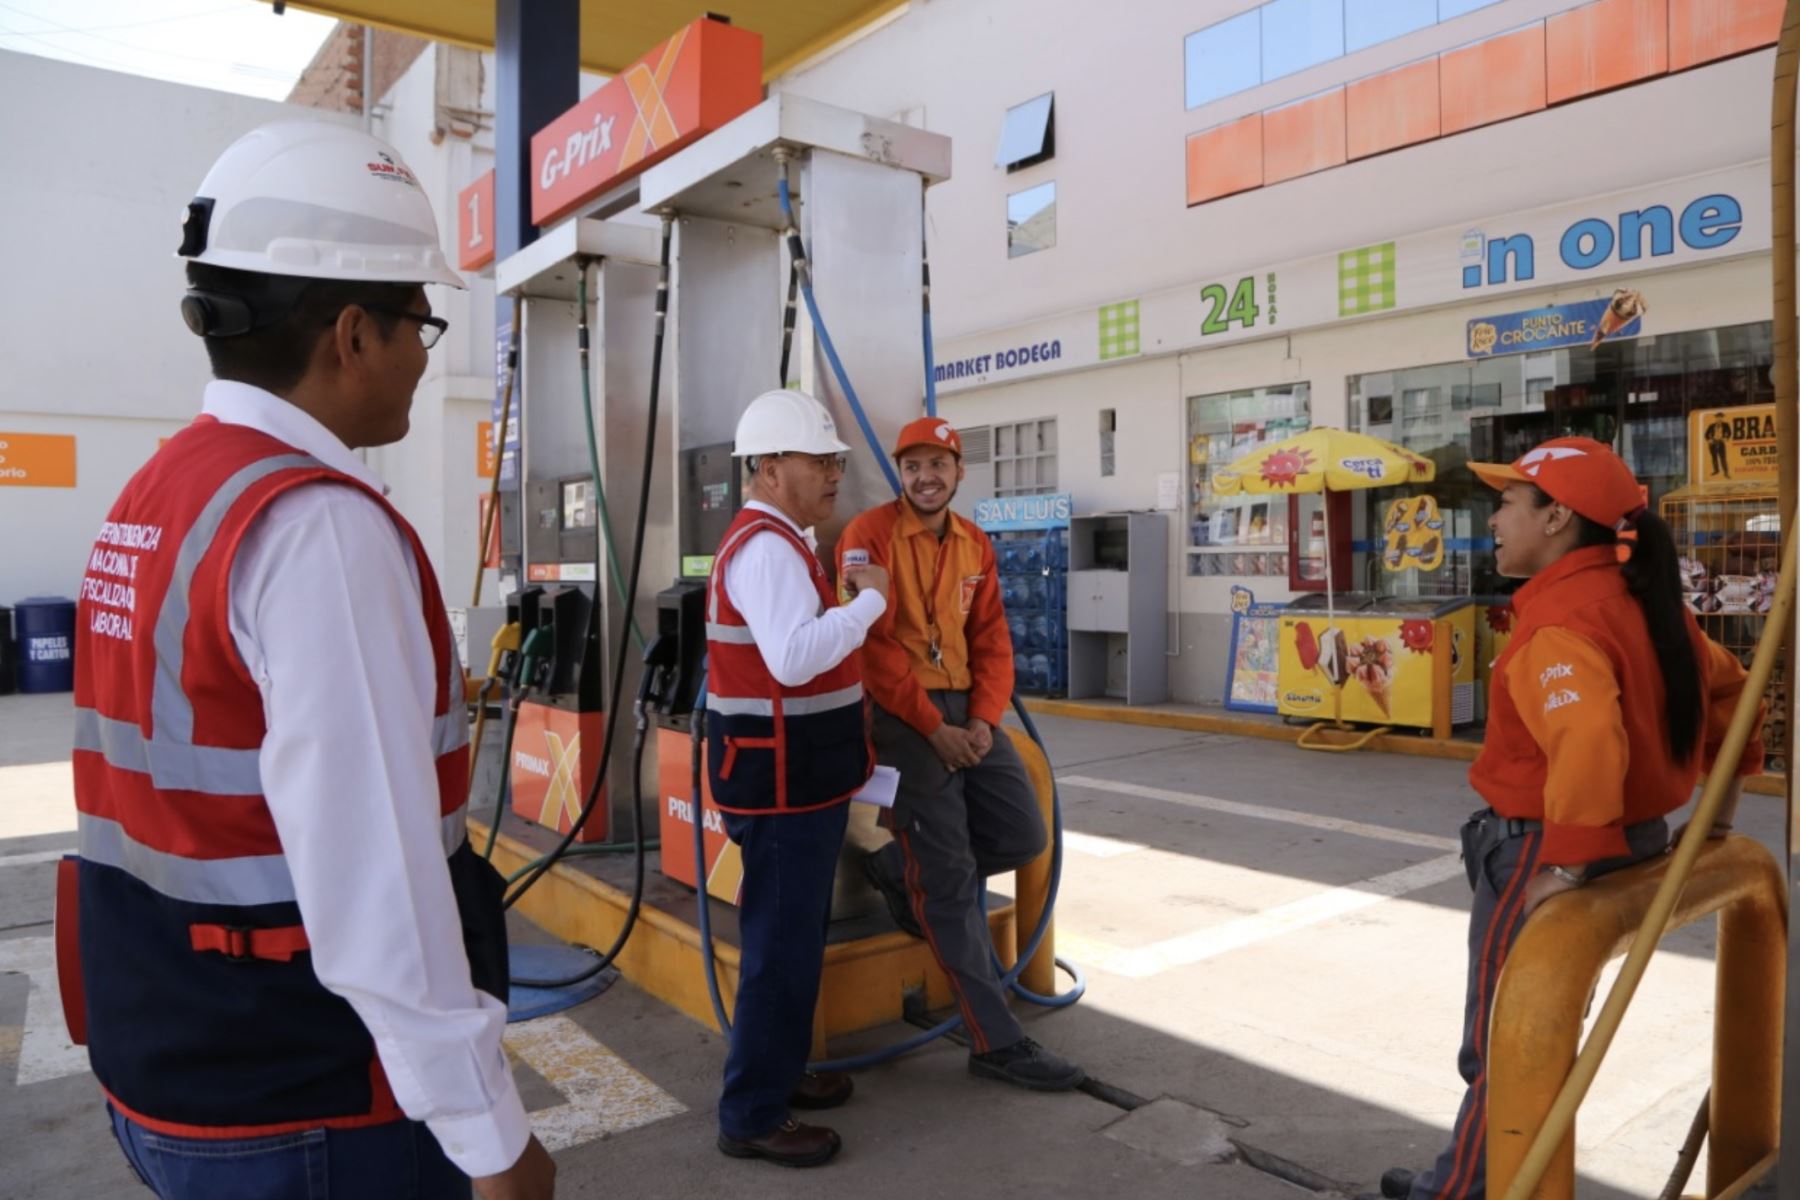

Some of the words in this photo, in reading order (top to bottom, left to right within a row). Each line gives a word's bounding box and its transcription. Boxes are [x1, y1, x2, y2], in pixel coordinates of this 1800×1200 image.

[540, 113, 615, 190] G-Prix
[468, 192, 483, 248] 1
[1559, 193, 1743, 270] one
[1200, 276, 1260, 336] 24
[1522, 313, 1563, 330] PUNTO
[1501, 320, 1586, 346] CROCANTE
[934, 354, 992, 382] MARKET
[996, 339, 1062, 370] BODEGA
[1732, 414, 1777, 440] BRA
[978, 502, 1017, 521] SAN
[1024, 498, 1069, 520] LUIS
[90, 607, 133, 640] LABORAL
[515, 751, 551, 777] PRIMAX
[667, 796, 724, 834] PRIAX
